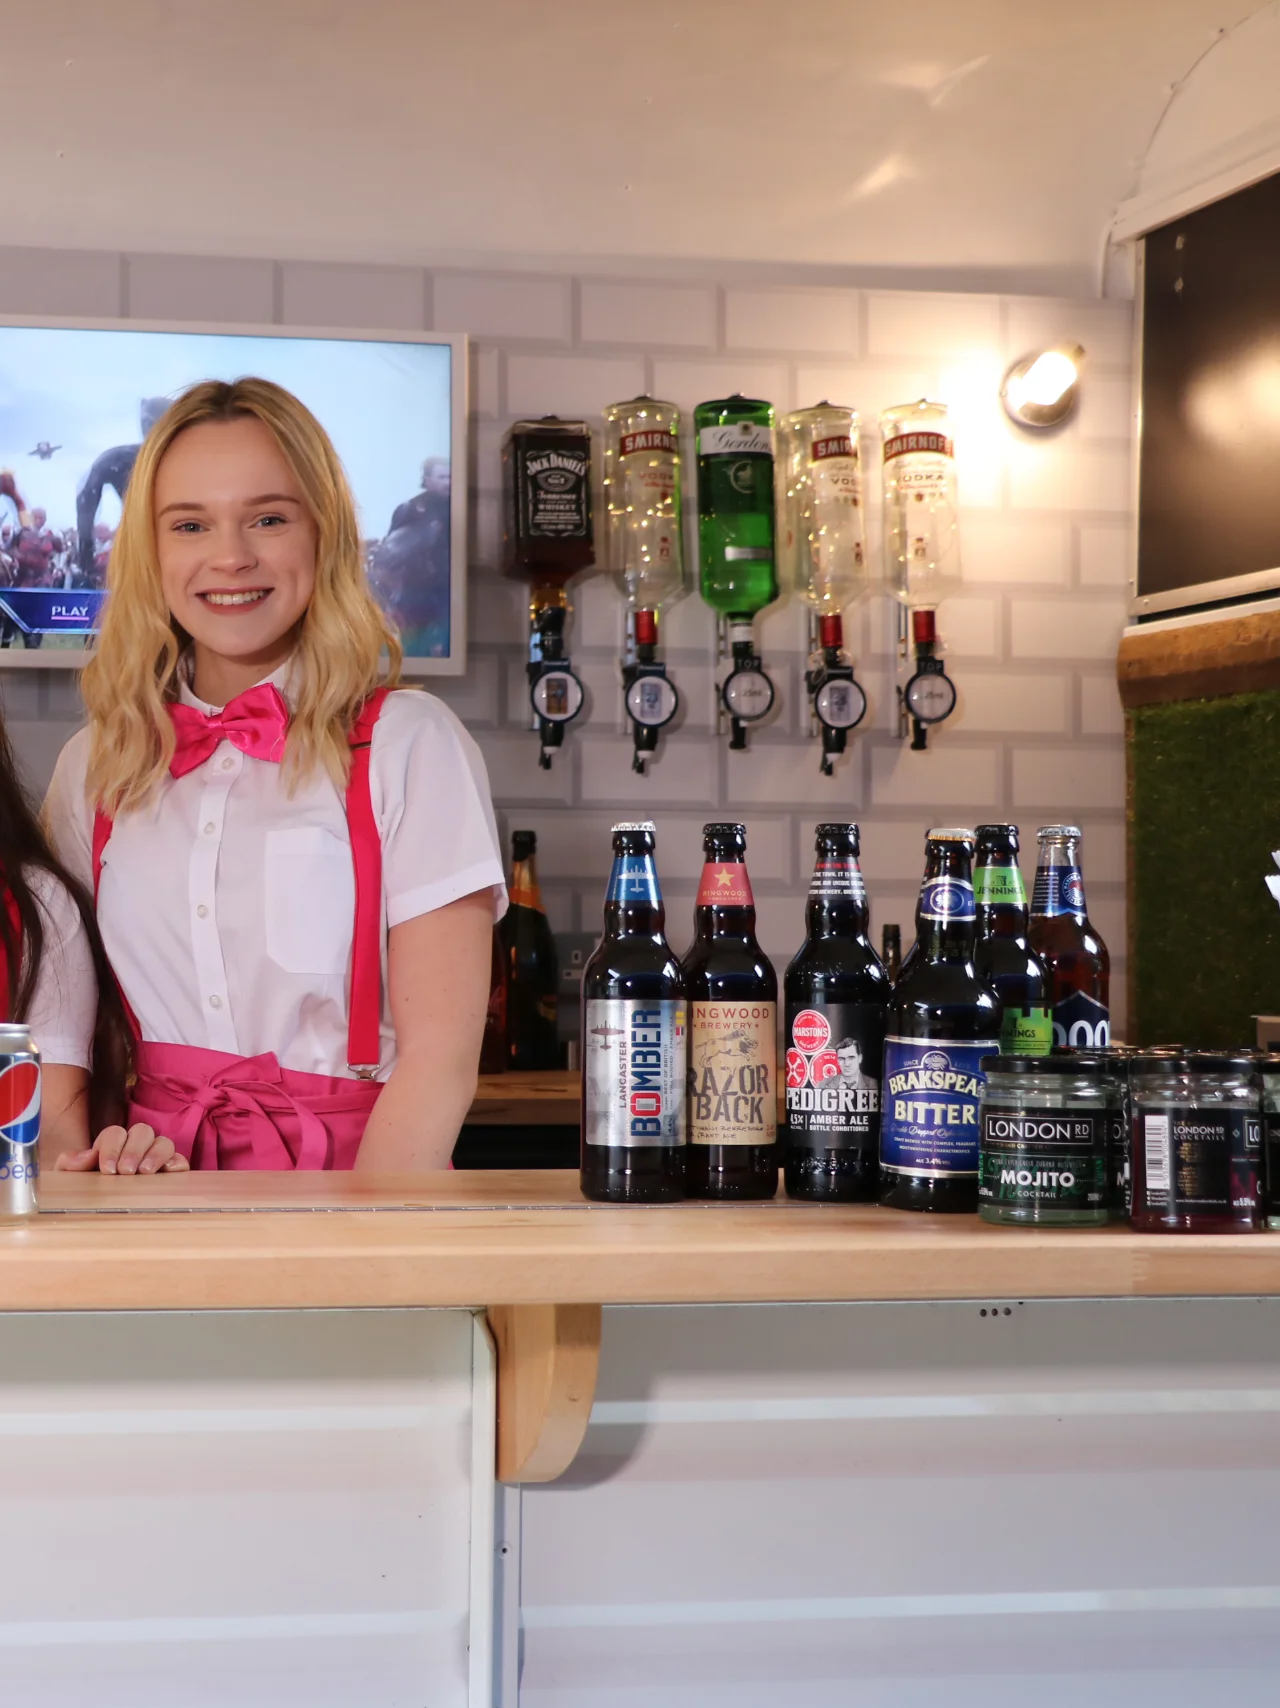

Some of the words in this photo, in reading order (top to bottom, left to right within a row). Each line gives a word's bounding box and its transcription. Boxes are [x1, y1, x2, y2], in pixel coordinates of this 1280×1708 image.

[526, 457, 549, 476] JACK
[549, 453, 587, 476] DANIEL'S
[51, 605, 89, 617] PLAY
[738, 660, 760, 668] TOP
[977, 886, 1023, 895] JENNINGS
[691, 1007, 770, 1020] INGWOOD
[700, 1021, 753, 1029] BREWERY
[793, 1026, 828, 1038] MARSTON'S
[903, 1059, 919, 1067] SINCE
[618, 1040, 627, 1109] LANCASTER
[630, 1009, 661, 1137] BOMBER
[687, 1063, 769, 1098] RAZOR
[888, 1070, 980, 1098] BRAKSPEA
[695, 1092, 764, 1124] BACK
[786, 1087, 879, 1113] PEDIGREE
[809, 1114, 846, 1125] AMBER
[849, 1114, 869, 1125] ALE
[894, 1100, 976, 1125] BITTER
[989, 1120, 1071, 1139] LONDON
[1074, 1123, 1089, 1135] RD
[1173, 1126, 1215, 1135] LONDON
[1000, 1169, 1075, 1188] MOJITO
[1017, 1190, 1057, 1199] COCKTAIL
